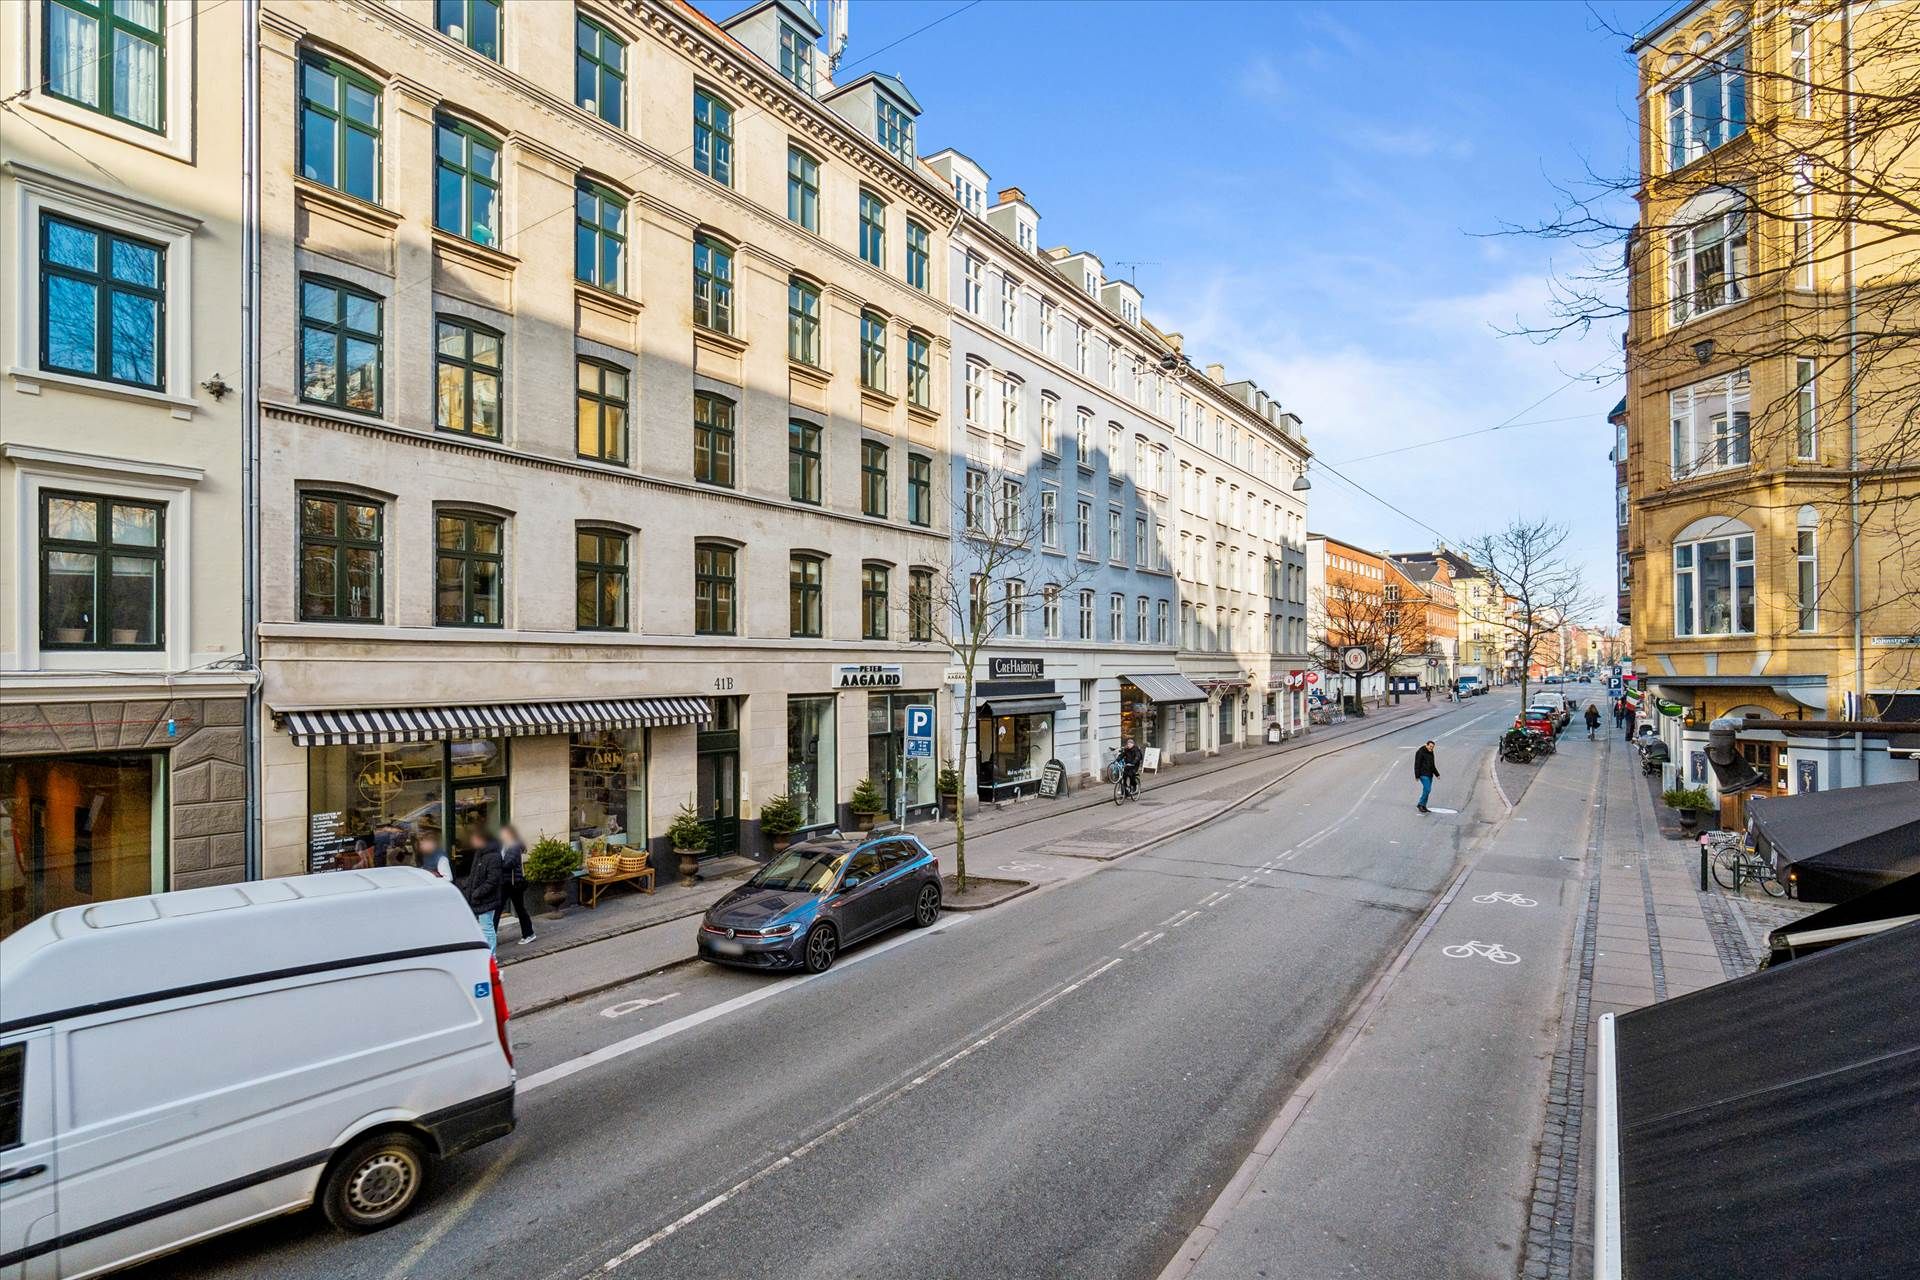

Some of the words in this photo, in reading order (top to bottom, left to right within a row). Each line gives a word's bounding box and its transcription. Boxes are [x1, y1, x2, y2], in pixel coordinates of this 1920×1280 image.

[714, 677, 734, 690] 41B
[840, 674, 900, 686] AAGAARD
[1610, 679, 1619, 688] P
[913, 711, 928, 734] P
